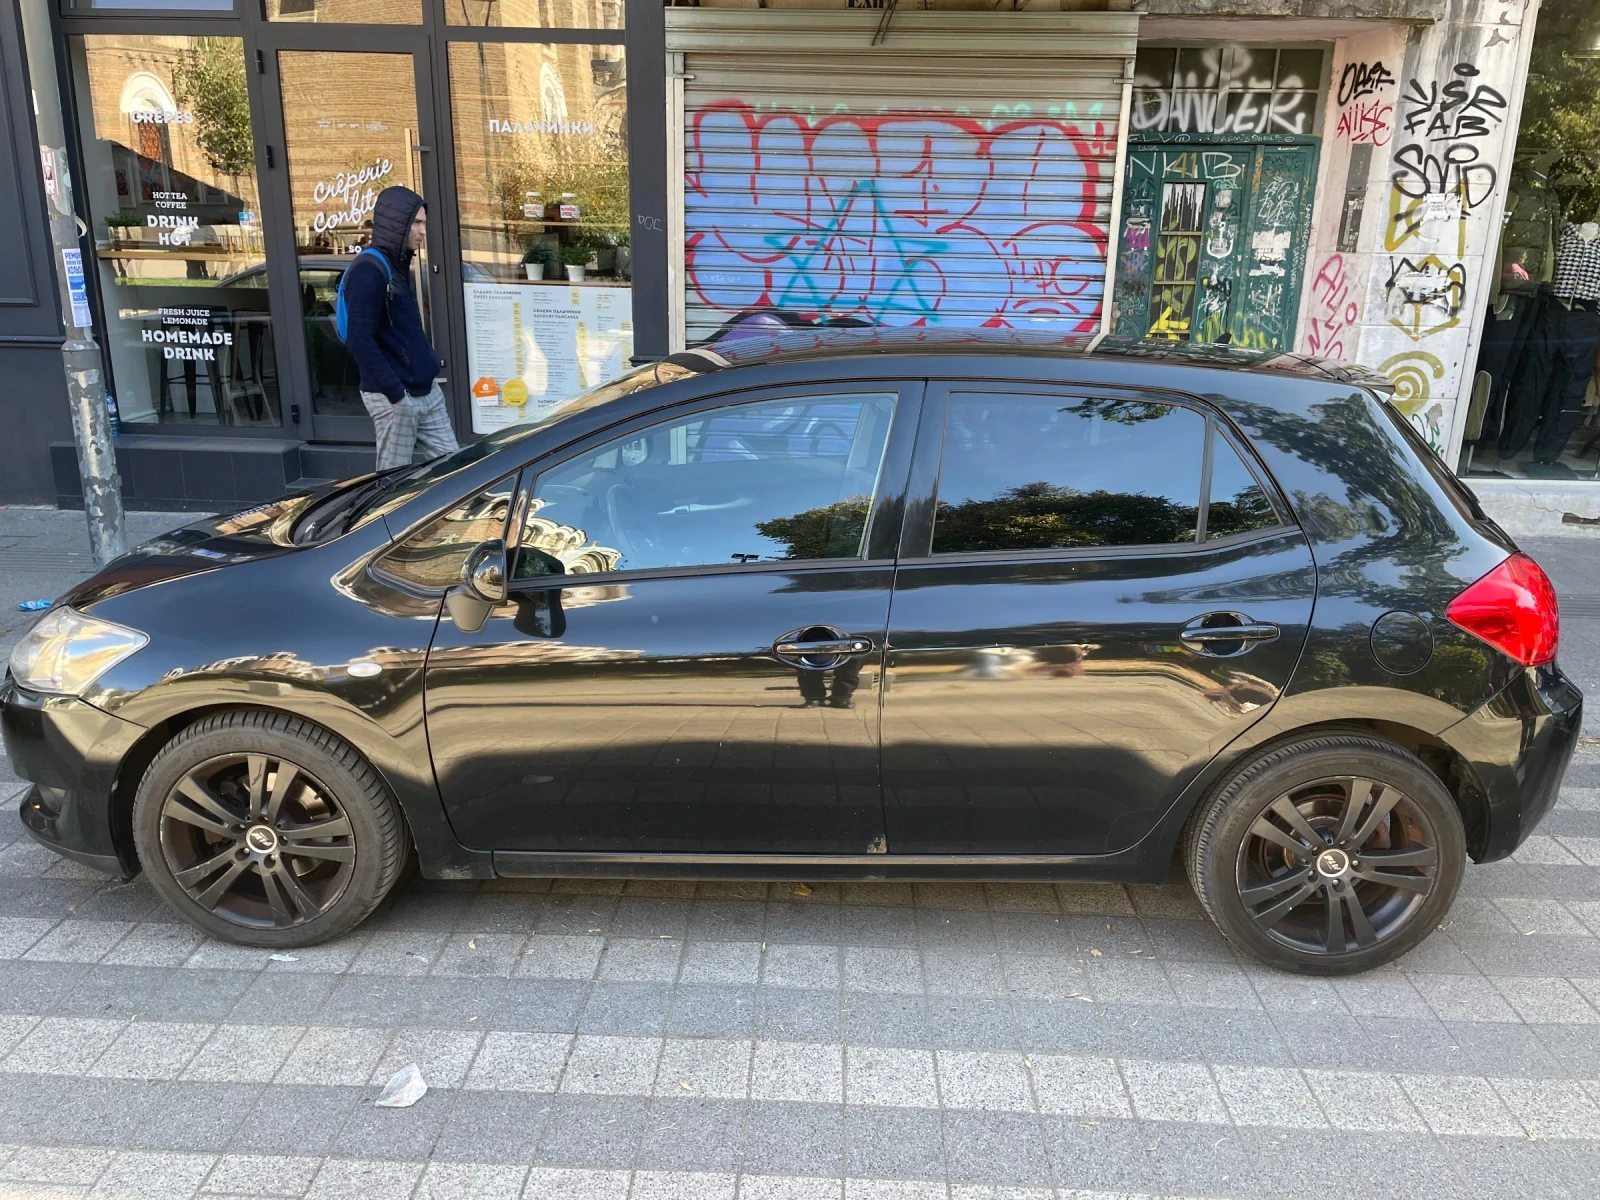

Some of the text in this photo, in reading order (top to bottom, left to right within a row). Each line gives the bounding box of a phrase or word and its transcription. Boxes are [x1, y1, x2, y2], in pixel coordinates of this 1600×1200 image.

[489, 119, 595, 134] ПАЛАЧИНКИ
[314, 158, 393, 204] Crêperie
[152, 191, 188, 200] HOT TEA
[155, 201, 187, 209] COFFEE
[314, 184, 398, 233] Confit
[147, 215, 200, 229] DRINK
[158, 232, 192, 246] HOT
[158, 308, 211, 317] FRESH JUICE
[162, 317, 208, 325] LEMONADE
[141, 329, 233, 346] HOMEMADE
[163, 346, 216, 361] DRINK
